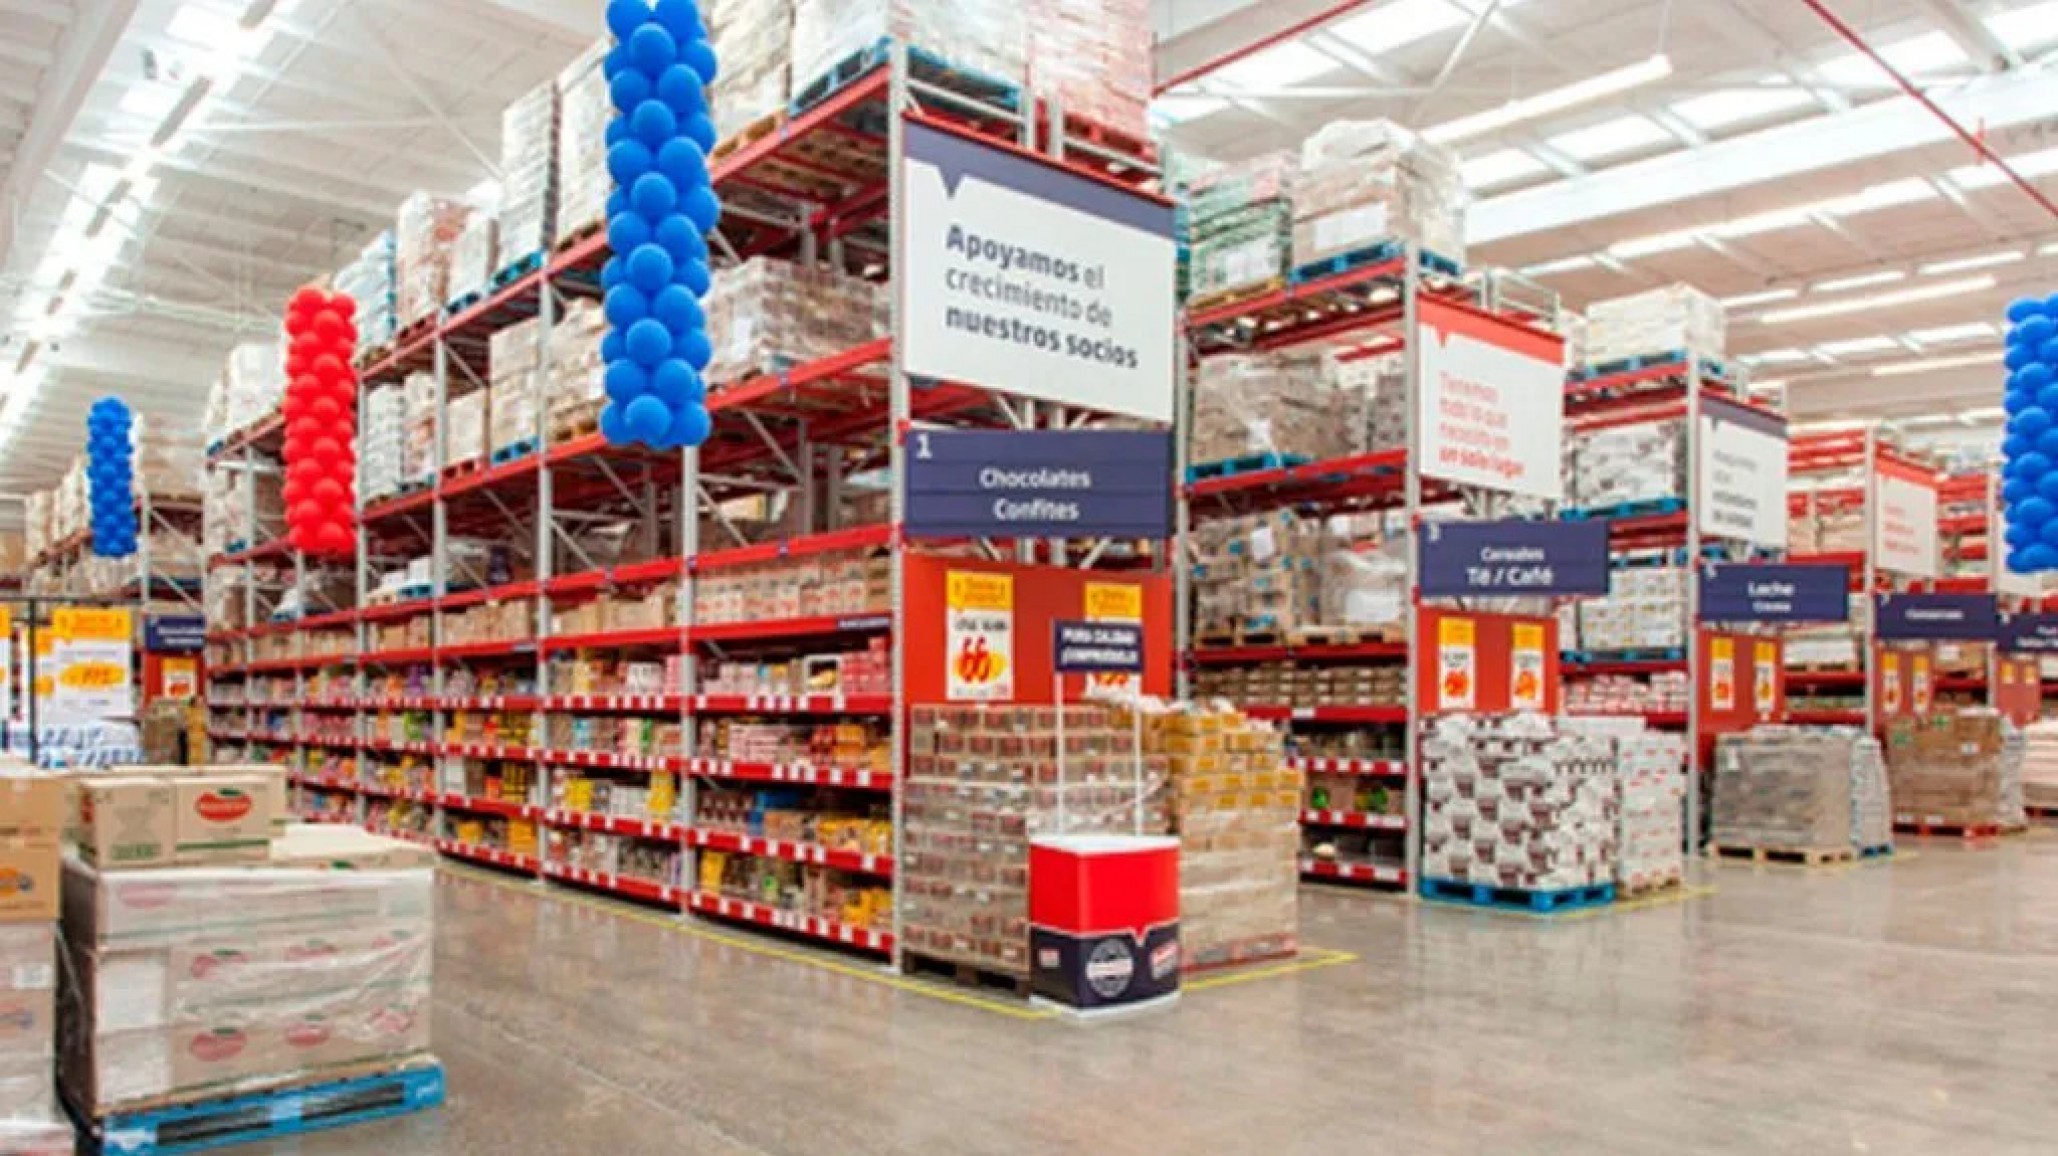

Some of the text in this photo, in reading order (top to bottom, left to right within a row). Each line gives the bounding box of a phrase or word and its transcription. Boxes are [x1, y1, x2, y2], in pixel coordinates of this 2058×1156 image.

[946, 224, 1104, 291] Apoyamos el
[945, 264, 1112, 329] crecimiento de
[946, 304, 1139, 369] nuestros socios
[915, 433, 932, 459] 1
[979, 466, 1092, 490] Chocolates
[1507, 565, 1553, 586] Café
